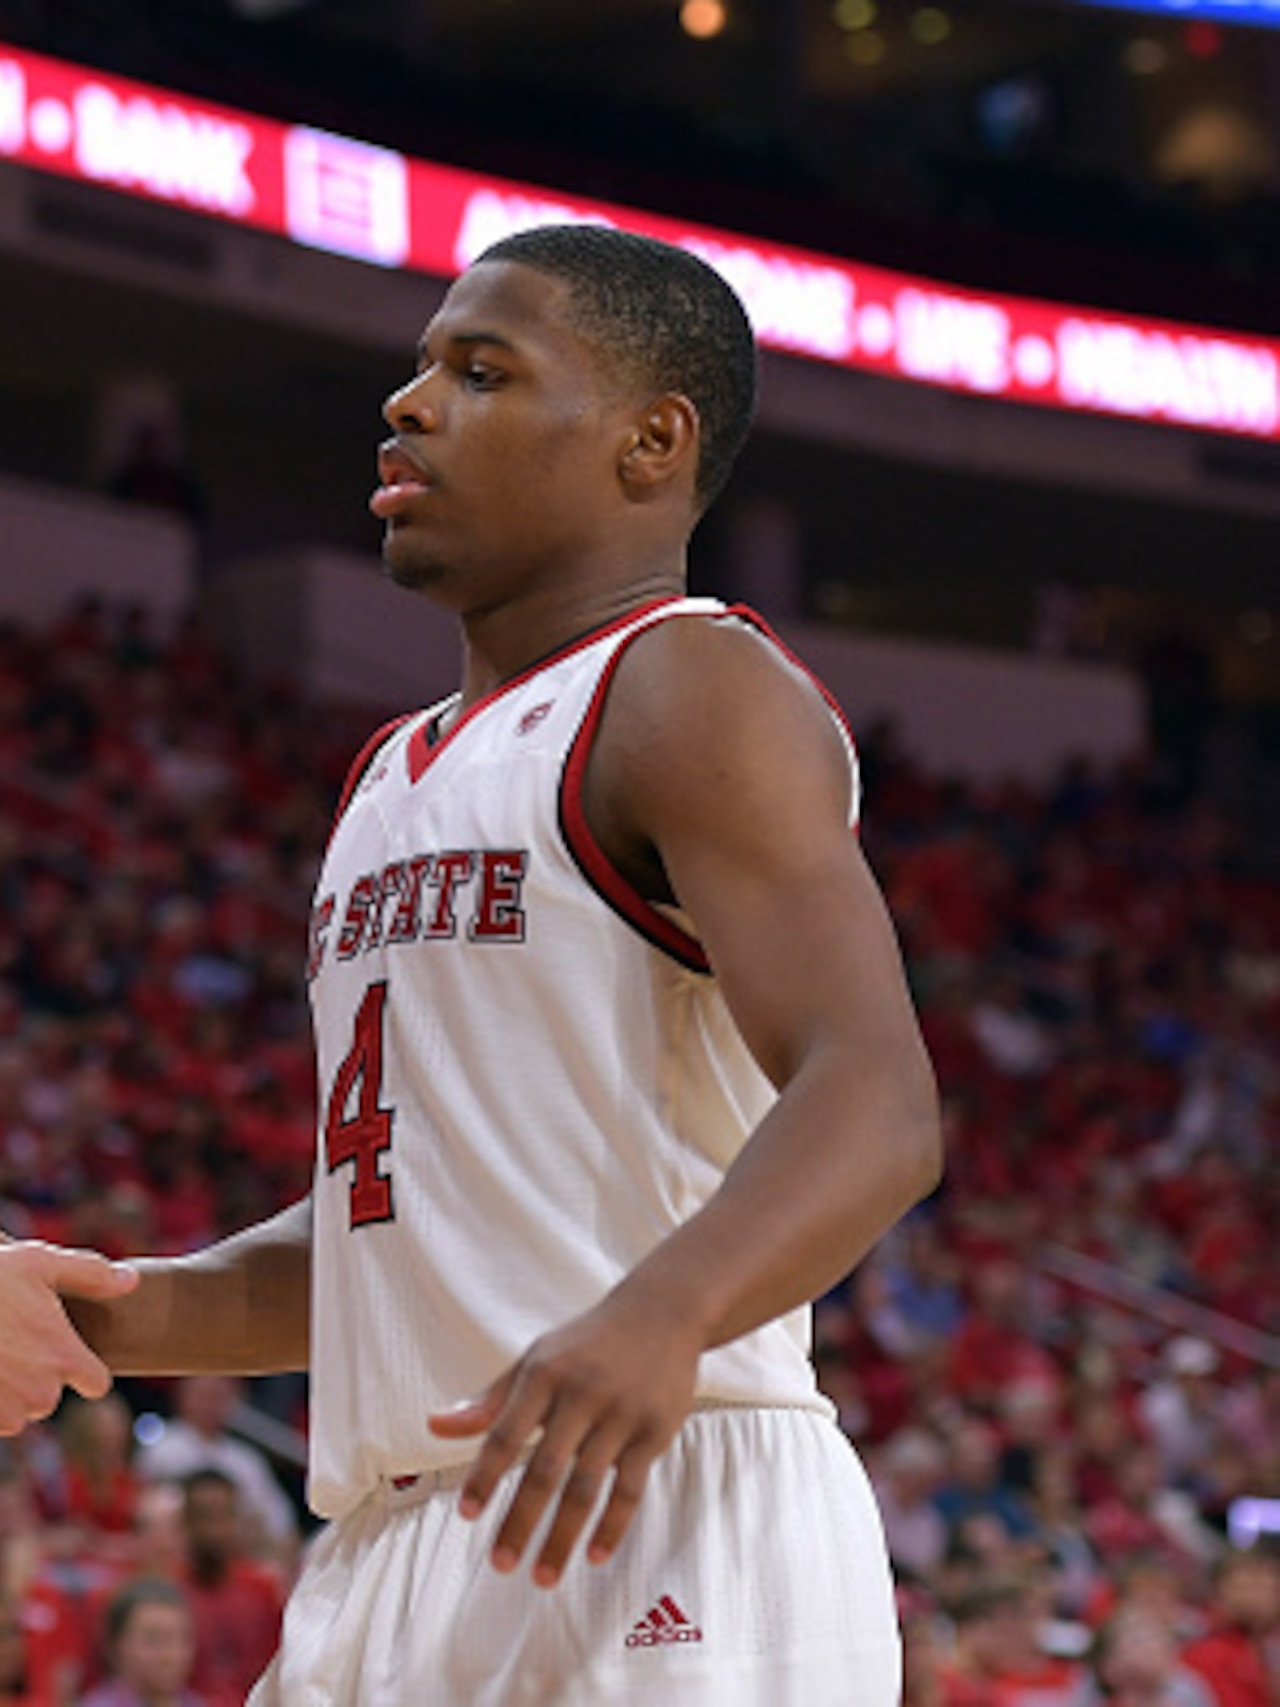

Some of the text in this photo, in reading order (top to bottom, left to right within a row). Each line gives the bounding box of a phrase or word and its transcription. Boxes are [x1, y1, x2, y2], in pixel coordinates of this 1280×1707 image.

[337, 850, 528, 961] STATE
[325, 980, 395, 1231] 4
[625, 1625, 702, 1648] adidas
